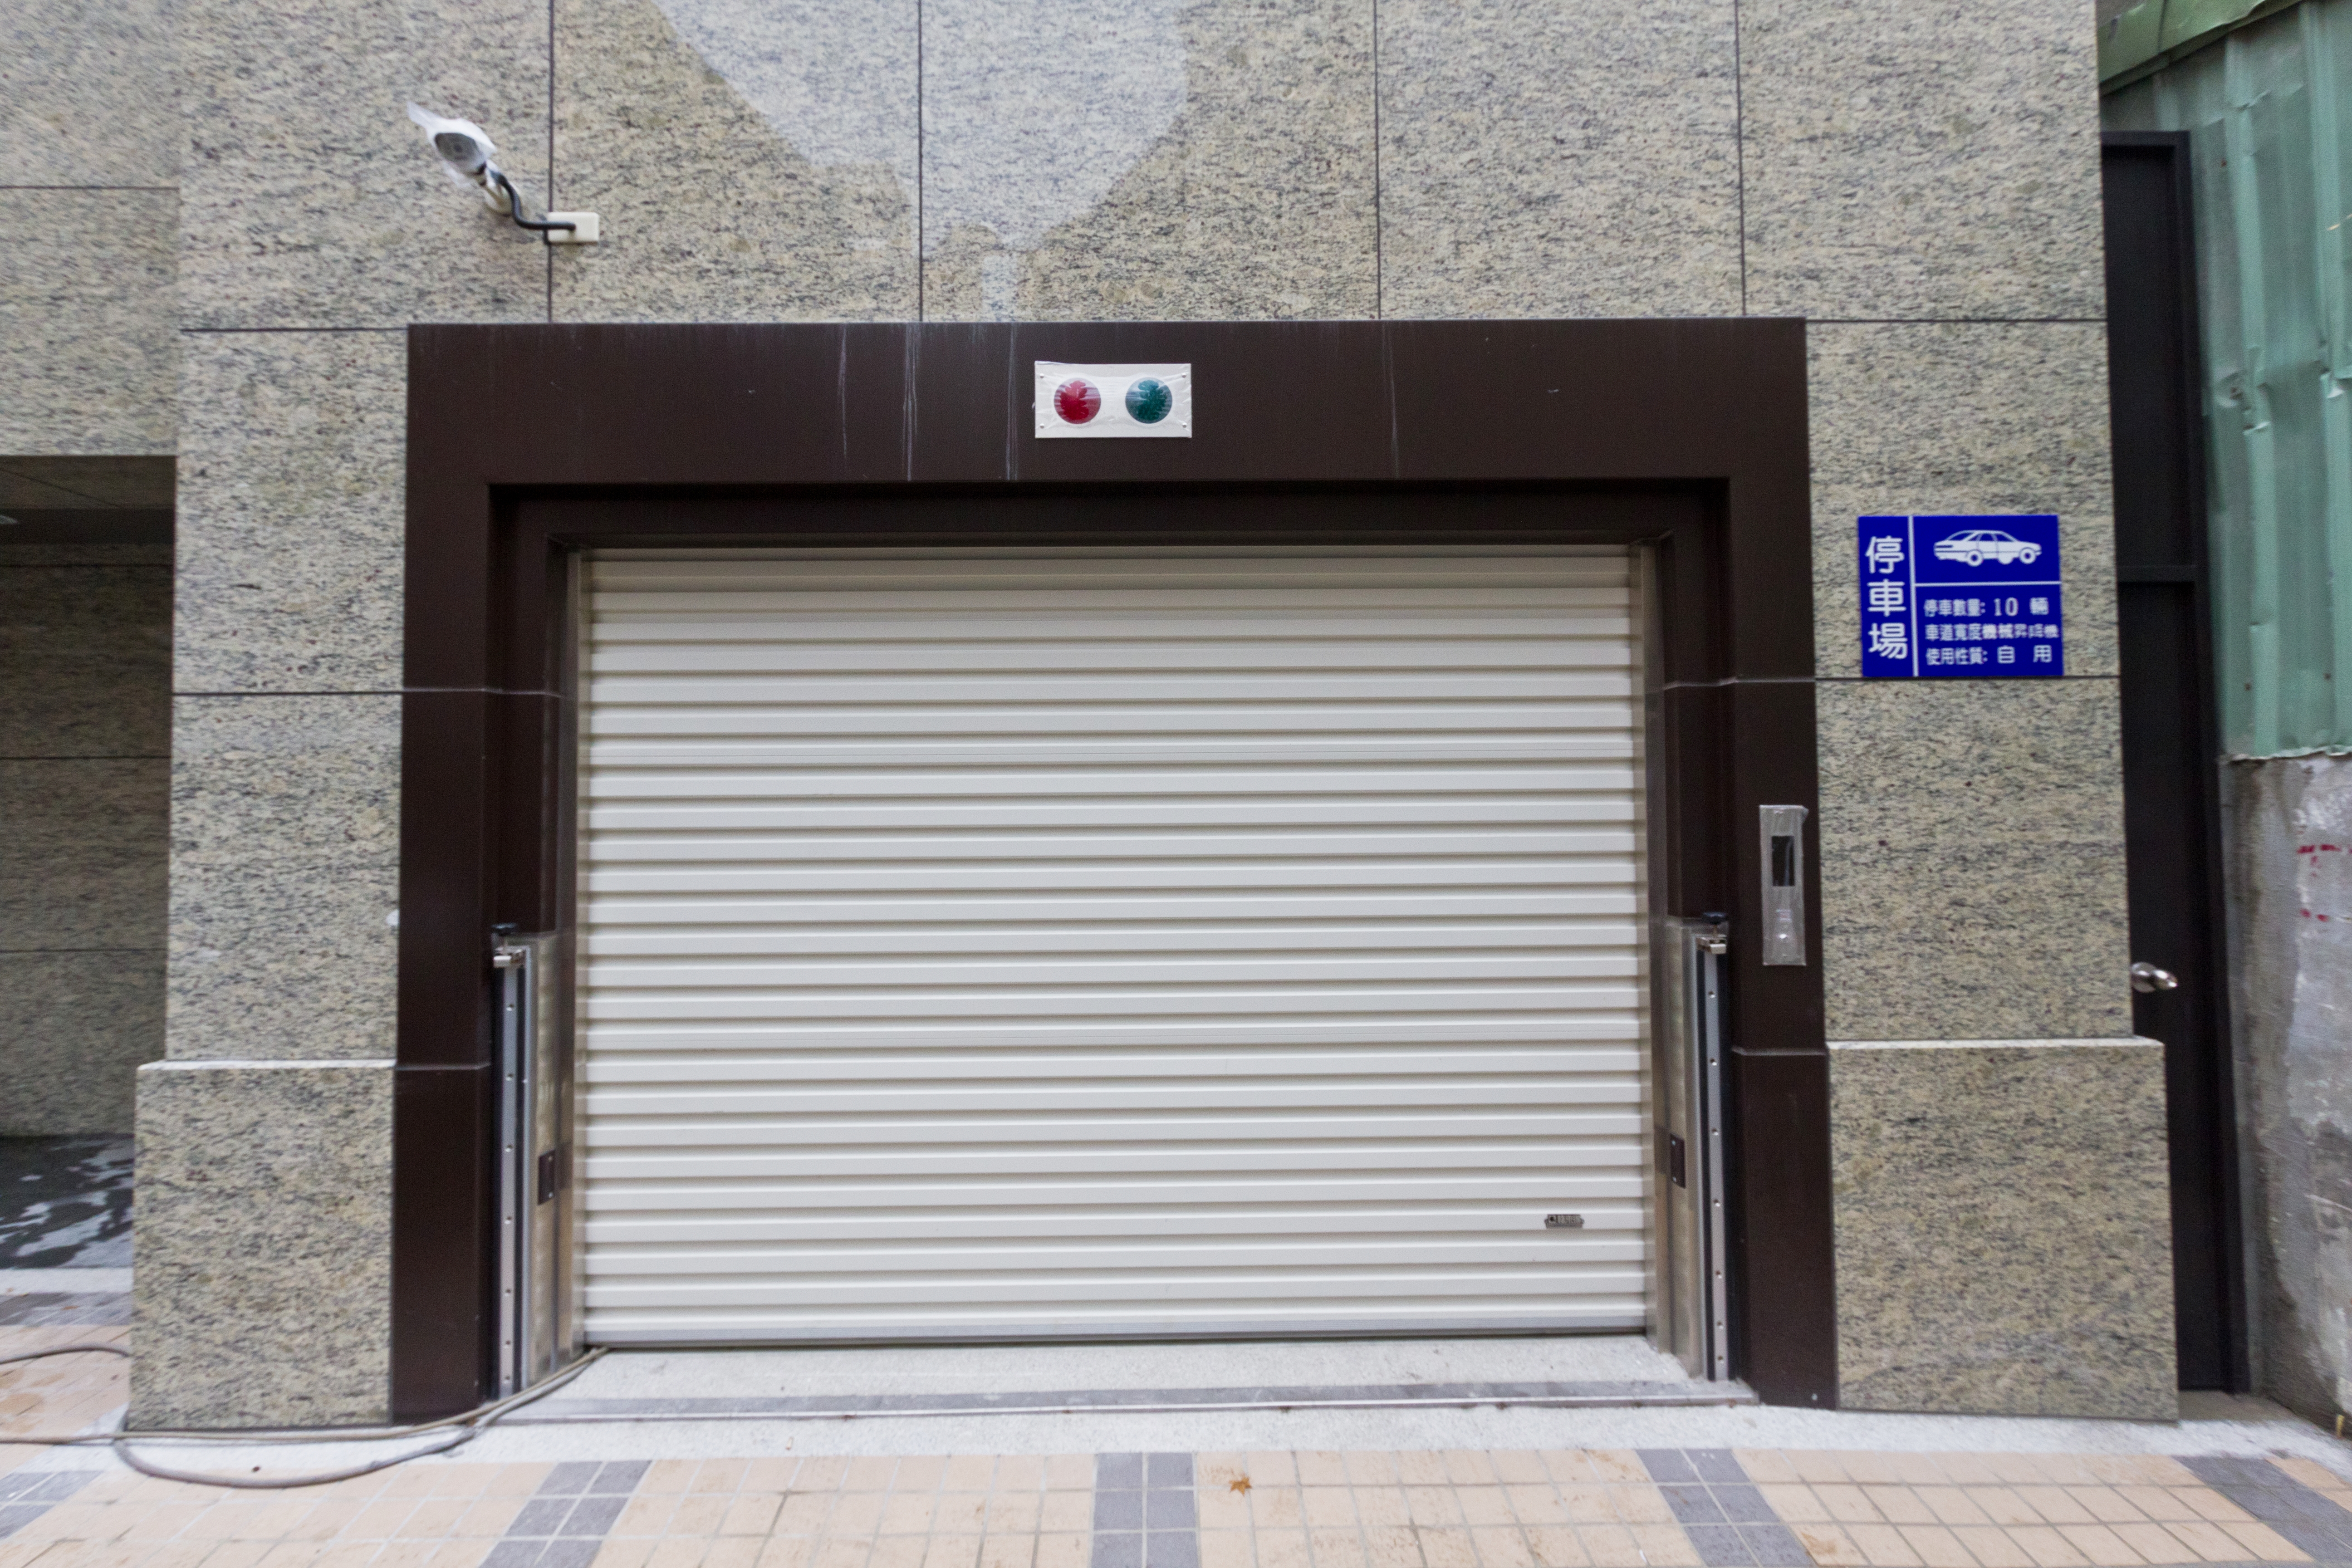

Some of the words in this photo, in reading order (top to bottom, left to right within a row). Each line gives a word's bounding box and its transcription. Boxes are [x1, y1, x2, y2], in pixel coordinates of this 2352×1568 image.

[1865, 535, 1908, 659] 停車場
[1994, 597, 2019, 616] 10
